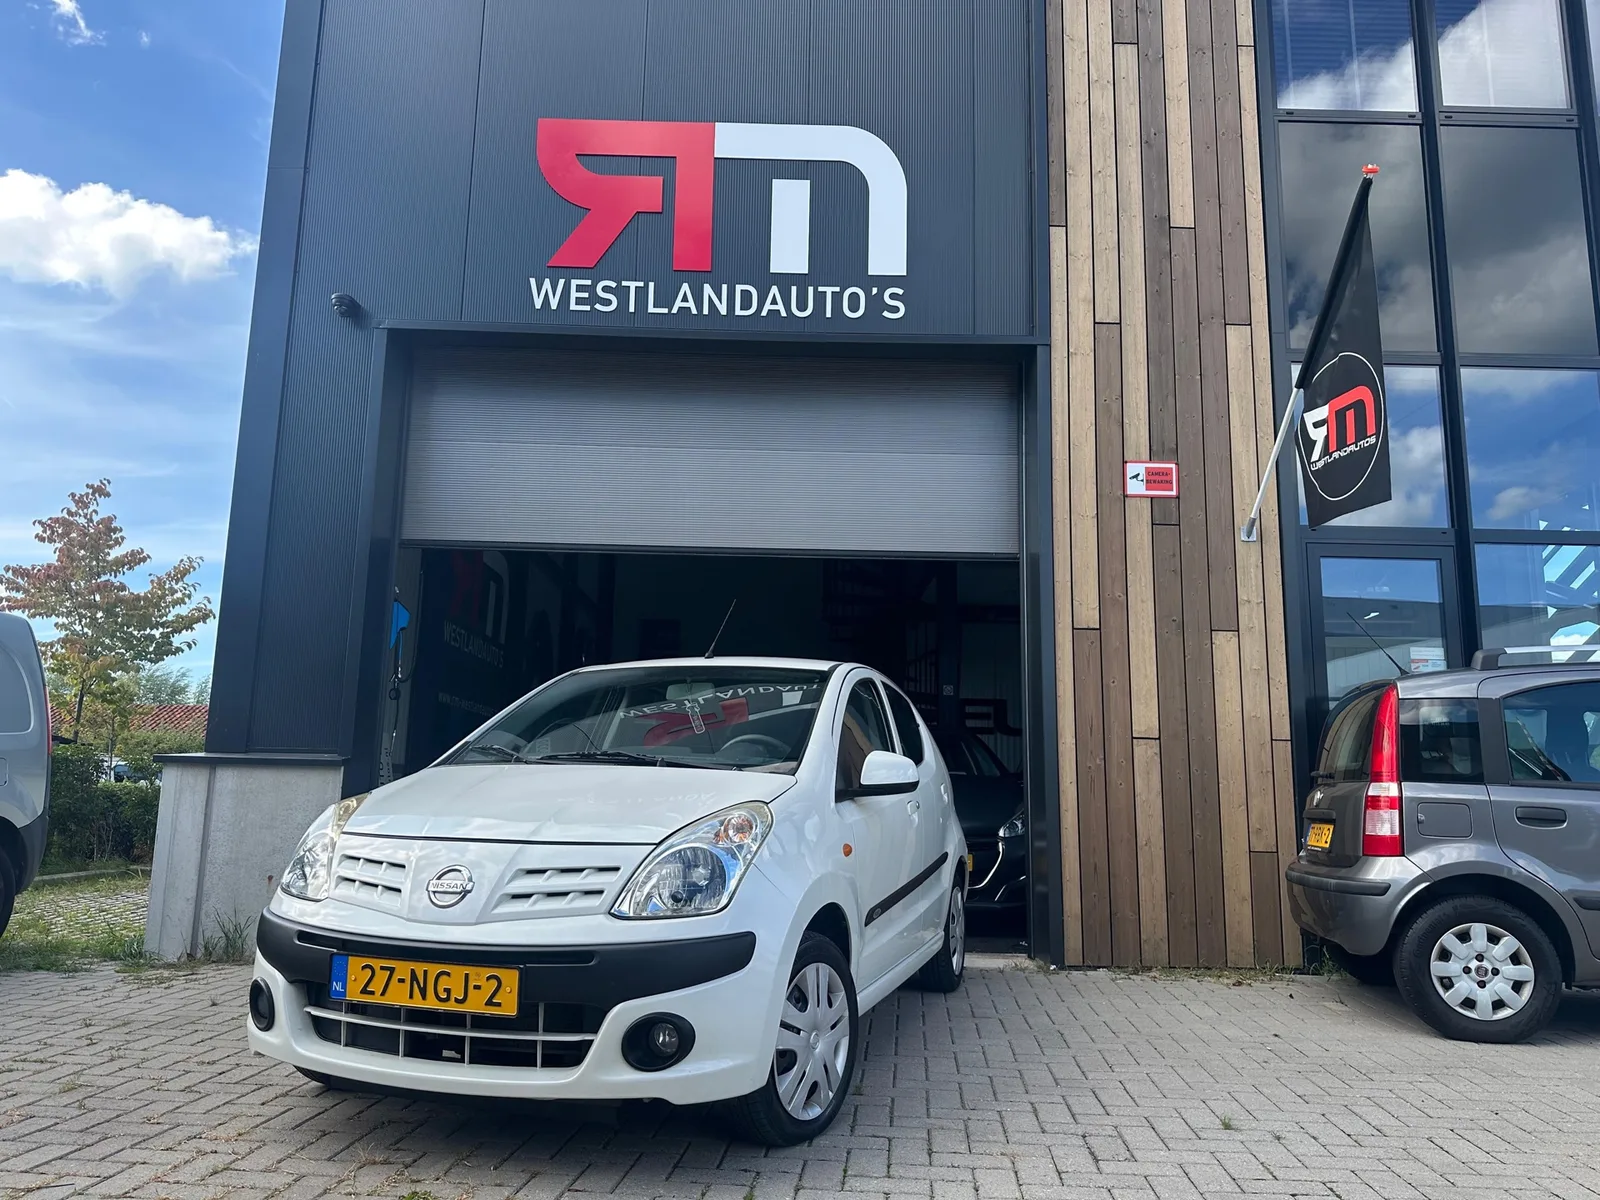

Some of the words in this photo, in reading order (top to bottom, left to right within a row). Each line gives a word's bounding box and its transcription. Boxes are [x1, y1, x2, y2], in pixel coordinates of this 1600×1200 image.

[529, 277, 906, 319] WESTLANDAUTO'S
[431, 882, 468, 890] NISSAN
[332, 981, 345, 992] NL
[359, 963, 503, 1007] 27-NGJ-2
